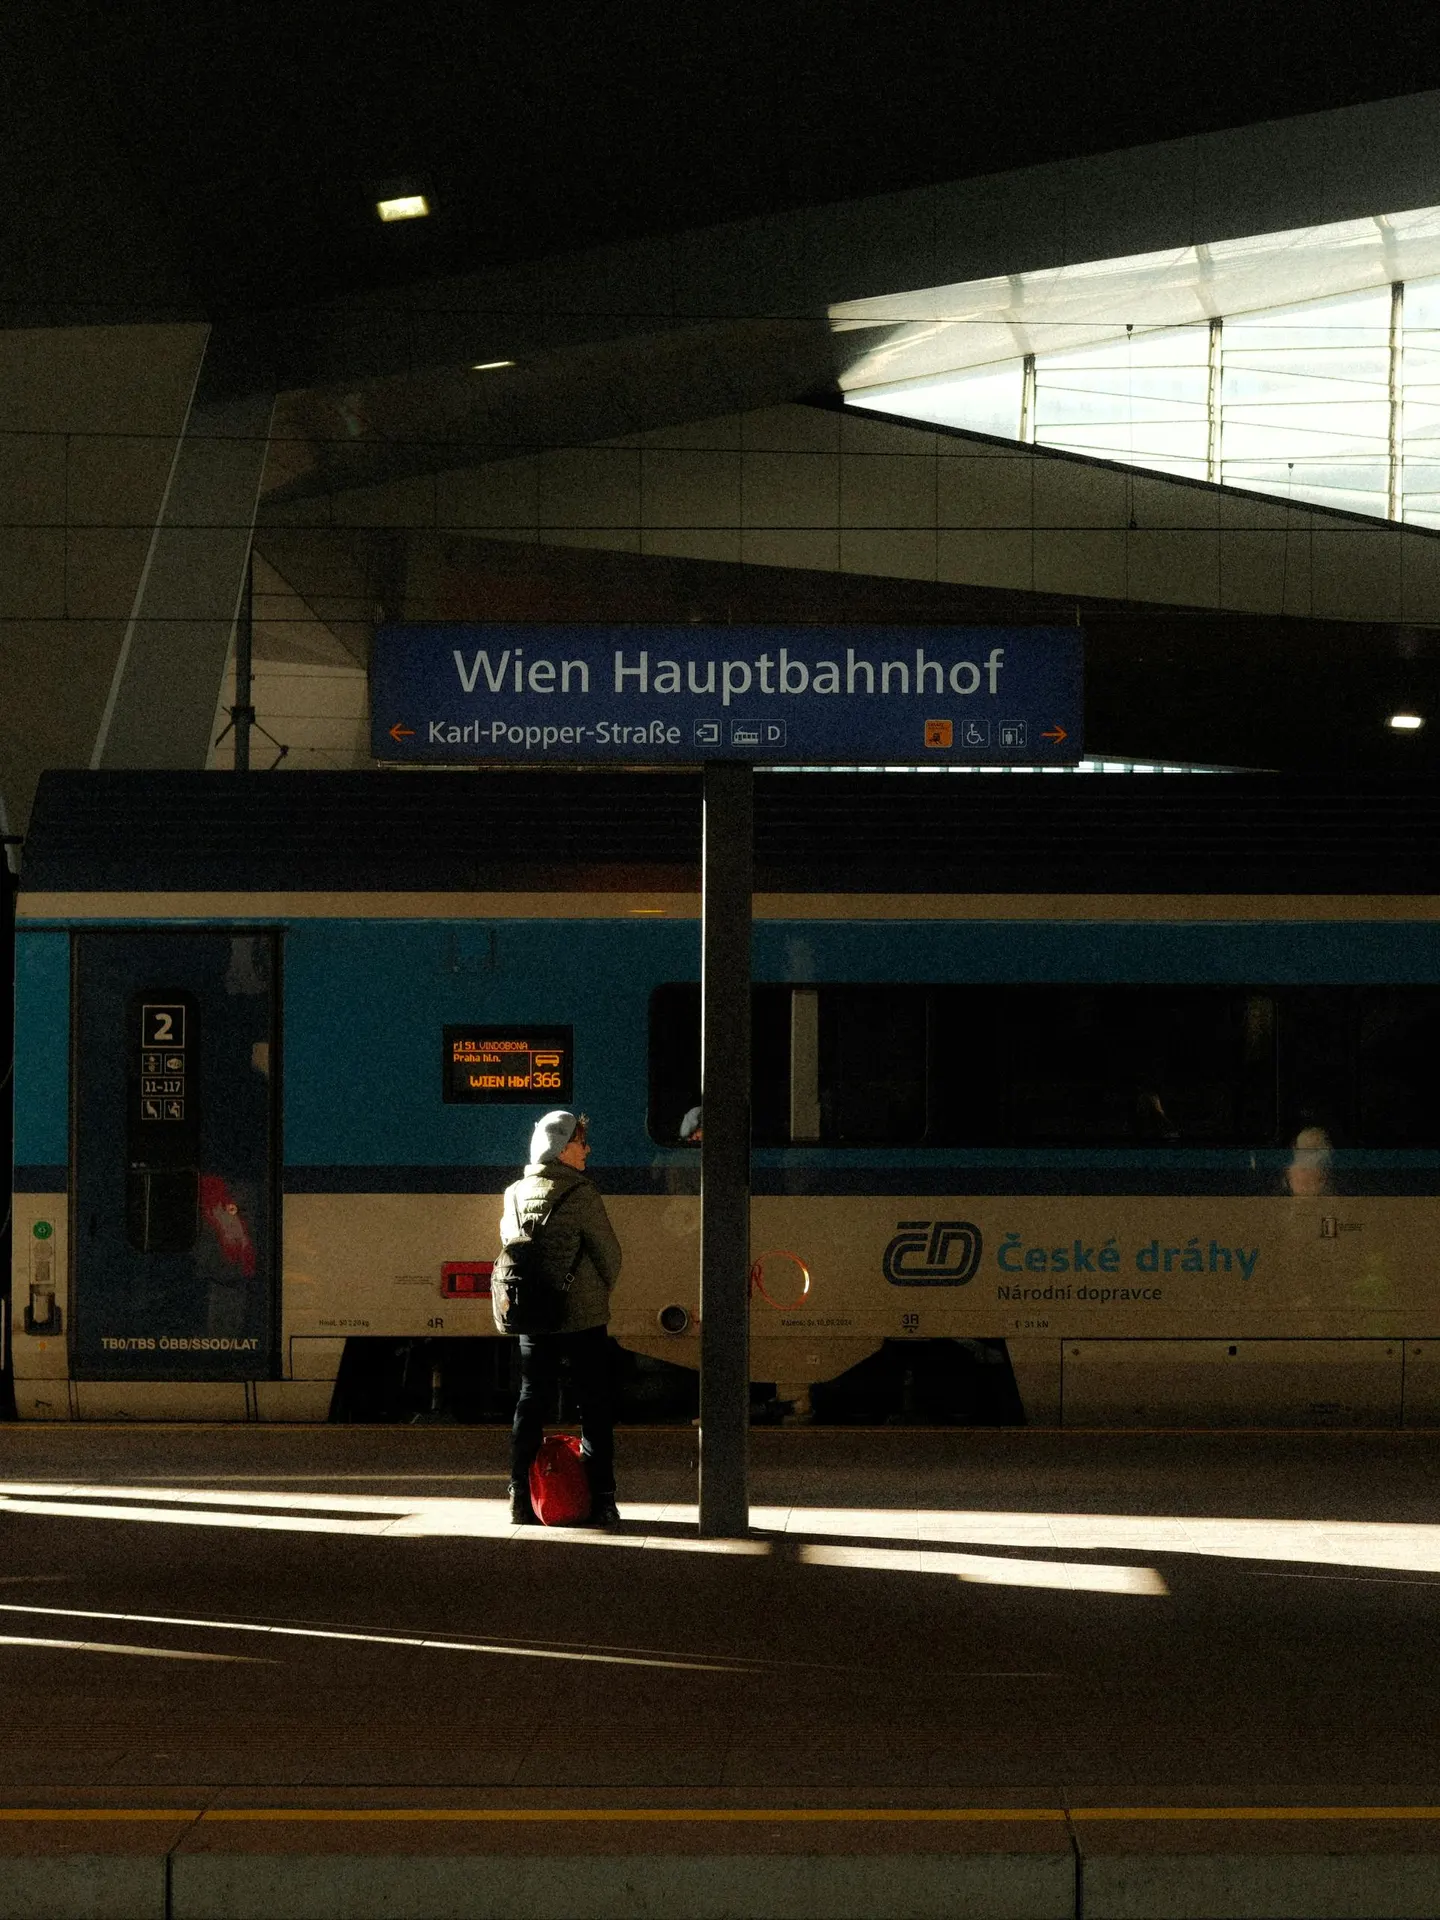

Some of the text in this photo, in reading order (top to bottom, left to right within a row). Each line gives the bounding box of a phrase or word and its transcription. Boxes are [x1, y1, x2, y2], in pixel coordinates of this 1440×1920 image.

[453, 648, 1005, 706] Wien Hauptbahnhof
[428, 719, 682, 749] Karl-Popper-Straße
[767, 725, 782, 741] D
[153, 1012, 174, 1041] 2
[479, 1041, 528, 1051] VINDOBONA
[453, 1053, 481, 1062] Praha
[144, 1081, 182, 1093] 11-117
[469, 1075, 530, 1088] WIEN Hbf
[532, 1071, 561, 1088] 366
[997, 1232, 1260, 1281] České dráhy
[997, 1284, 1163, 1303] Národní dopravce
[427, 1317, 444, 1329] 4R
[902, 1314, 919, 1325] 3R
